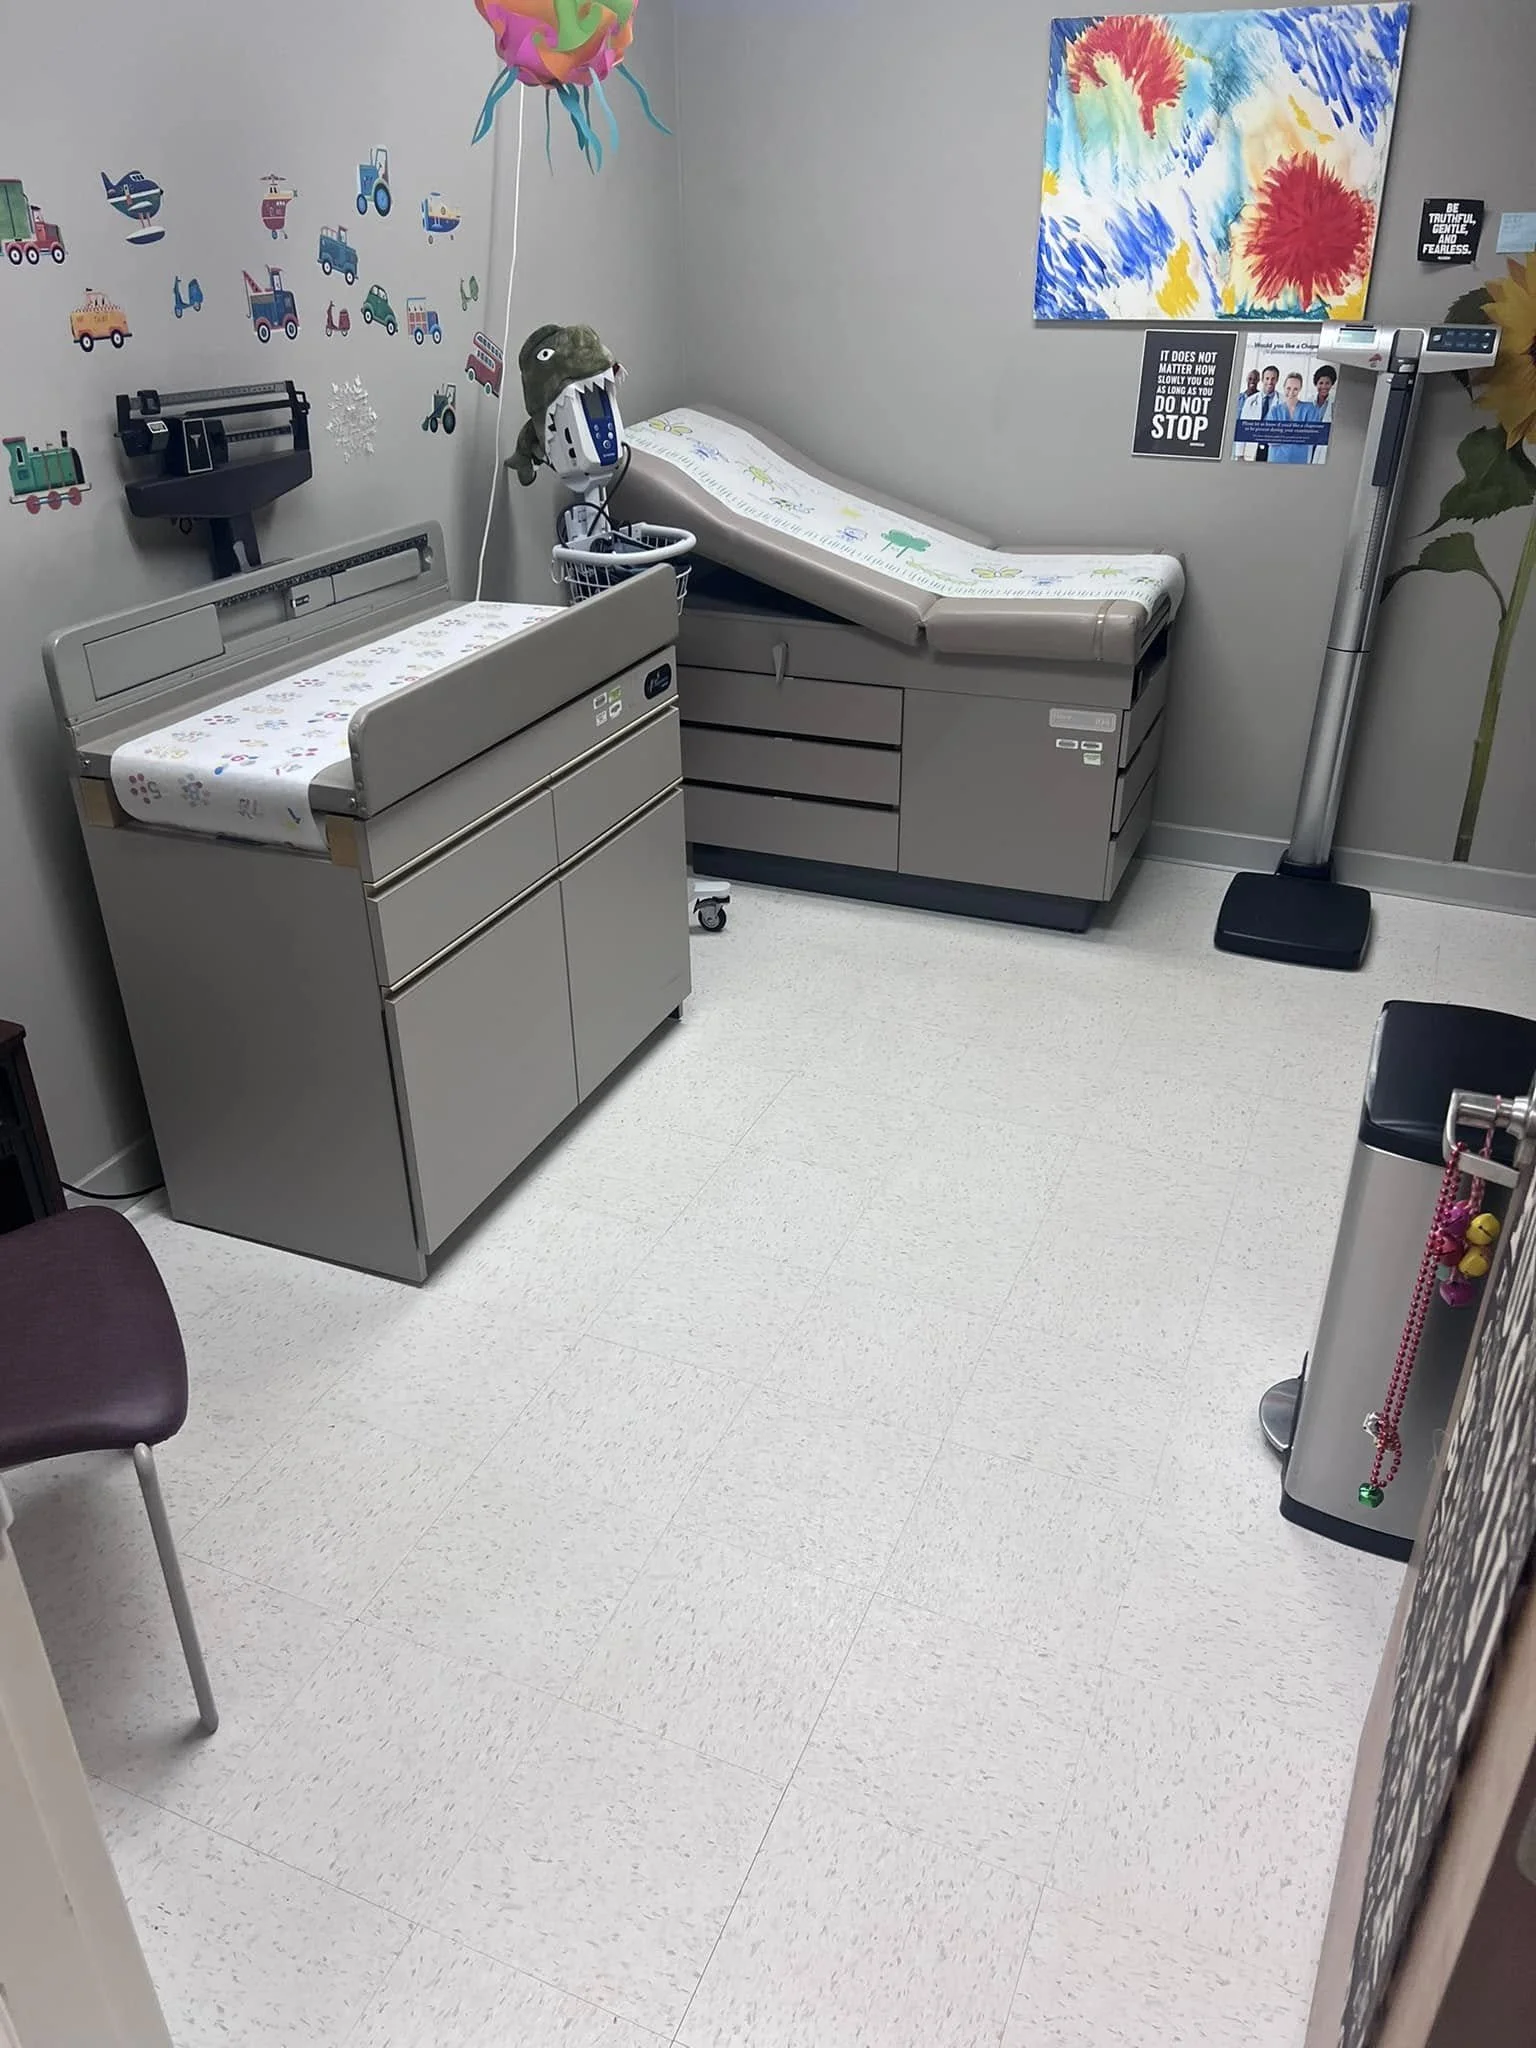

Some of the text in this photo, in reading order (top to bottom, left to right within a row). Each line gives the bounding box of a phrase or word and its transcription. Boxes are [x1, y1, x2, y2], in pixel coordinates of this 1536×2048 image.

[1446, 202, 1460, 213] BE
[1428, 213, 1476, 226] TRUTHFUL,
[1432, 224, 1468, 236] GENTLE,
[1438, 234, 1458, 244] AND
[1422, 244, 1472, 254] FEARLESS.
[1160, 350, 1218, 363] IT DOES NOT
[1159, 363, 1216, 375] MATTER HOW
[1157, 375, 1214, 386] SLOWLY YOU GO
[1156, 385, 1213, 396] AS LONG AS YOU
[1154, 395, 1212, 415] DO NOT
[1151, 414, 1208, 441] STOP
